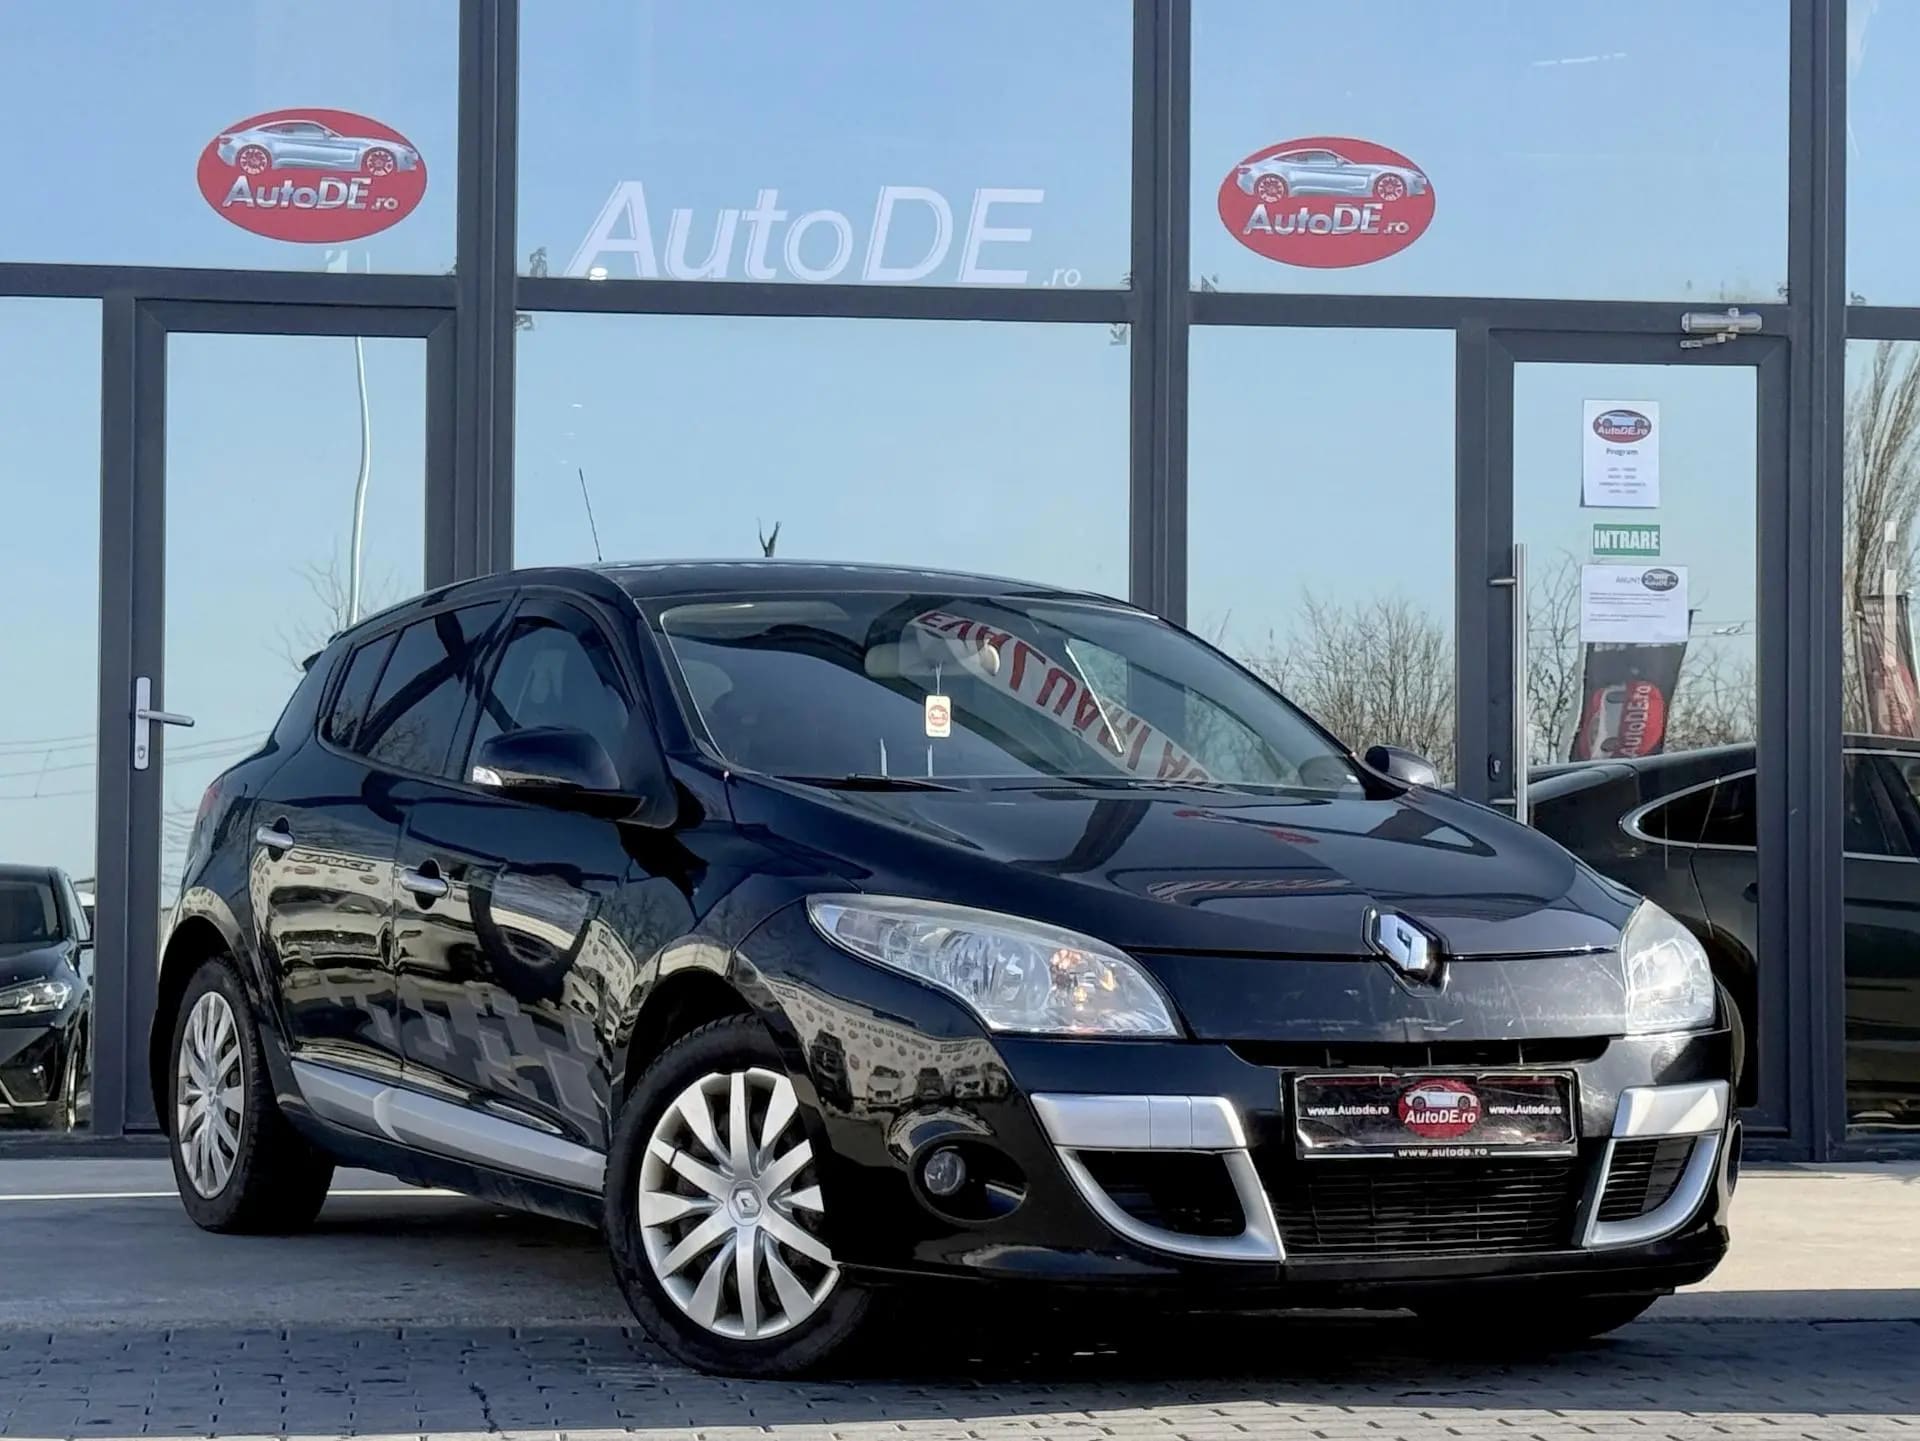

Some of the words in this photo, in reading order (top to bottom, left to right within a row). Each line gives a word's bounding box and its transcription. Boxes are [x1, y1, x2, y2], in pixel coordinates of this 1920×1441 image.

[1606, 448, 1639, 456] Program
[1594, 529, 1659, 550] INTRARE
[1405, 1110, 1476, 1124] AutoDE.ro
[1398, 1147, 1488, 1158] www.autode.ro
